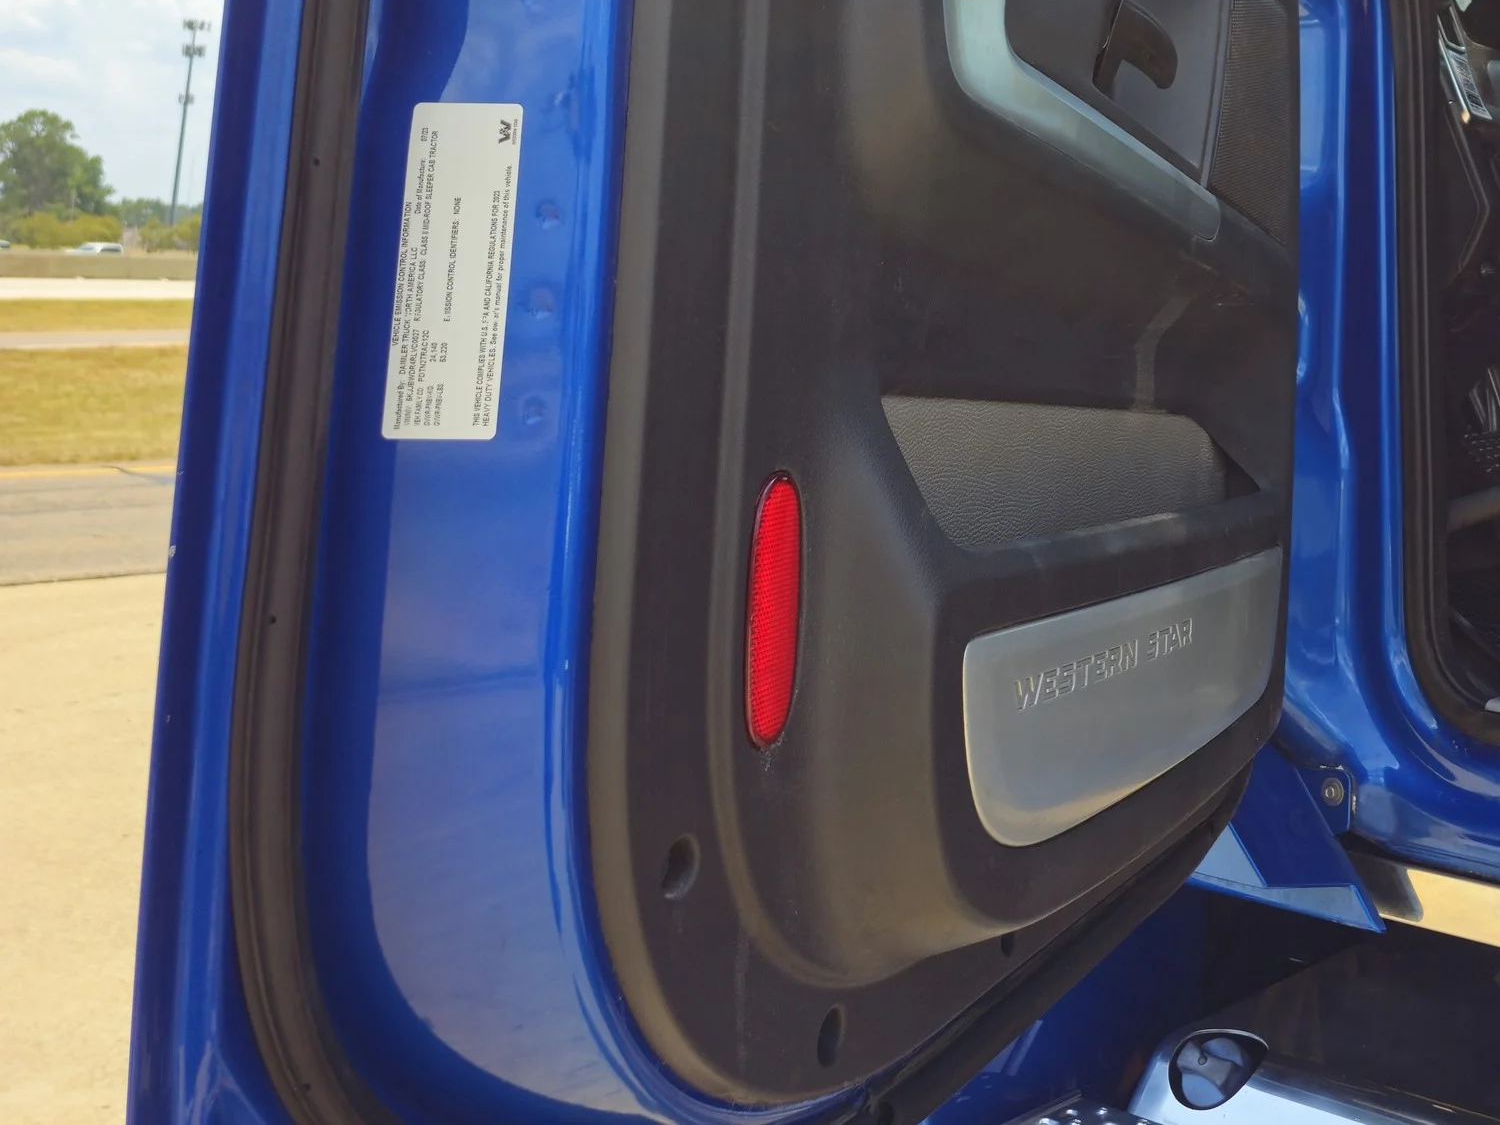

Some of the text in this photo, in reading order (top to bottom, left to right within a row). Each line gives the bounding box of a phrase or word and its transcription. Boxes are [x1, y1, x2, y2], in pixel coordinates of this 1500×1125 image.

[430, 130, 438, 158] TRACTOR
[428, 159, 436, 172] CAB
[504, 163, 512, 187] vehicle.
[426, 173, 434, 199] SLEEPER
[414, 203, 422, 214] Date
[422, 201, 431, 230] MID-ROOF
[491, 205, 499, 217] FOR
[450, 219, 460, 259] IDENTIFIERS:
[488, 217, 498, 259] REGULATIONS
[499, 210, 509, 249] maintenance
[408, 247, 418, 259] LLC
[420, 236, 428, 255] CLASS
[418, 258, 428, 279] CLASS:
[498, 251, 507, 271] proper
[392, 201, 412, 346] VEHICLE EMISSION CONTROL INFORMATION
[406, 263, 416, 292] AMERICA
[446, 261, 457, 291] CONTROL
[484, 261, 495, 297] CALIFORNIA
[483, 297, 491, 310] AND
[494, 283, 502, 306] manual
[402, 319, 410, 341] TRUCK
[479, 337, 487, 353] WITH
[399, 345, 408, 375] DAIMLER
[476, 355, 486, 385] COMPLIES
[487, 347, 496, 381] VEHICLES.
[474, 387, 483, 411] VEHICLE
[485, 382, 493, 401] DUTY
[483, 403, 491, 427] HEAVY
[1013, 618, 1193, 712] WESTERN STAR
